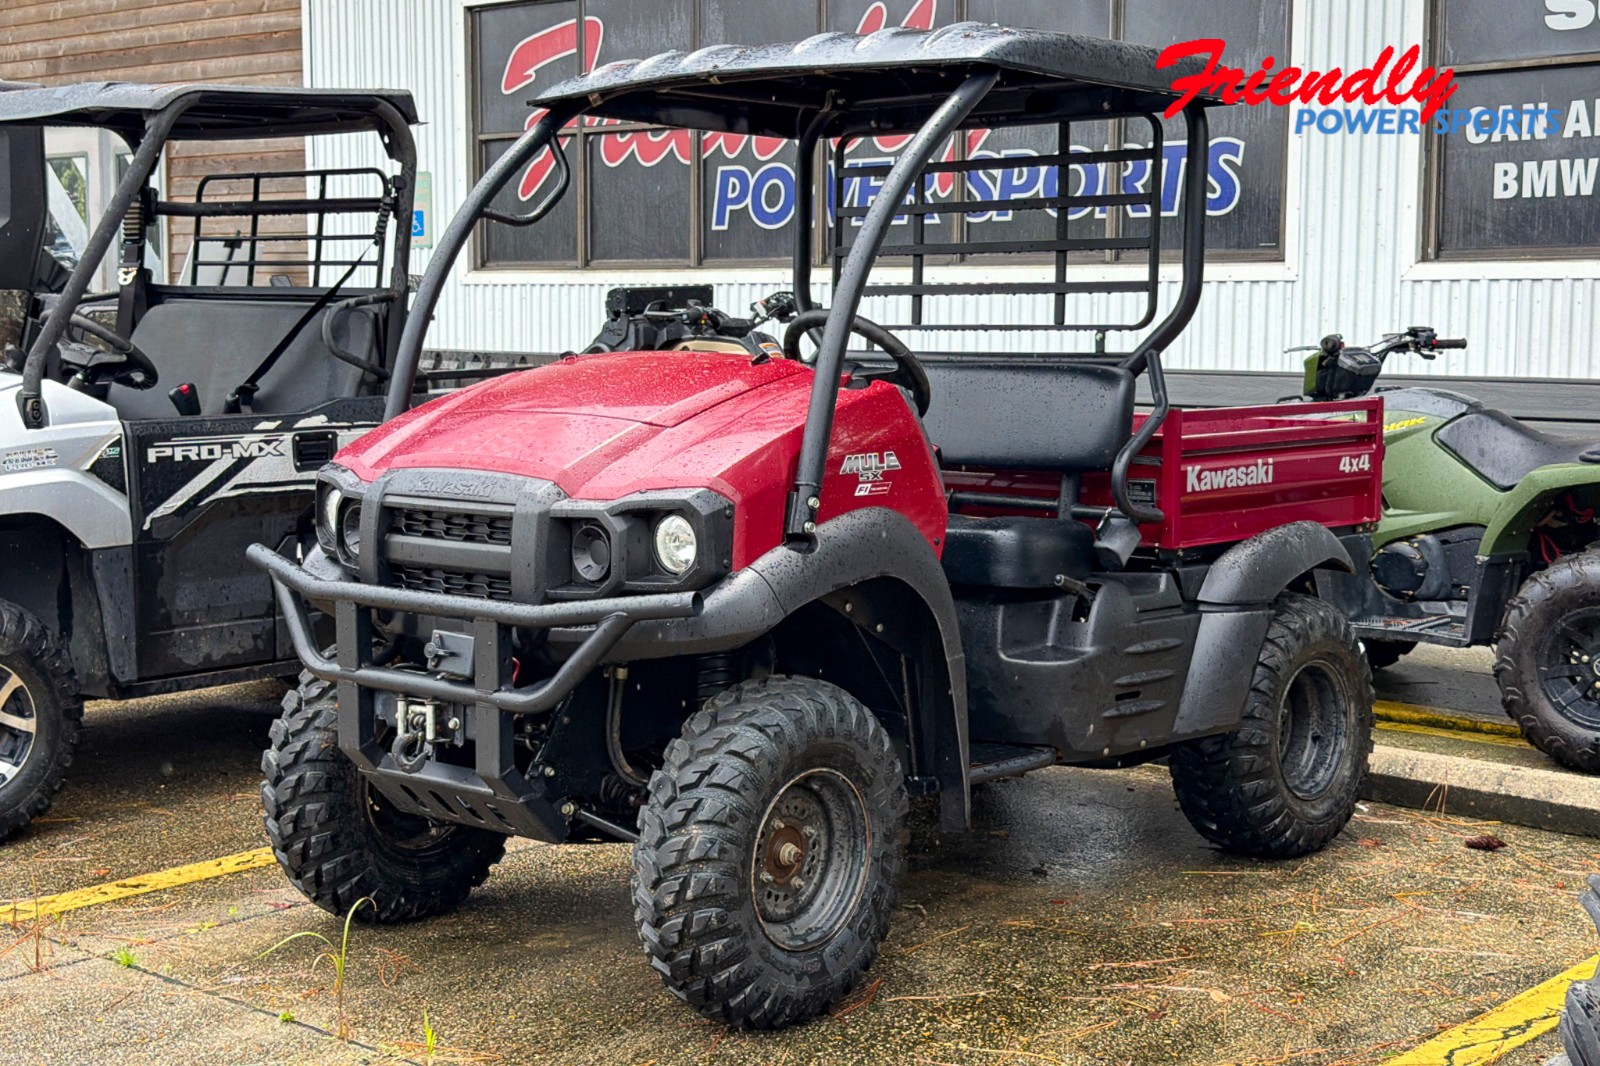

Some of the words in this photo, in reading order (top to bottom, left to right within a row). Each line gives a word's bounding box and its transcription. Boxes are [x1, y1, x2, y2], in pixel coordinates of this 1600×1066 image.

[1562, 99, 1600, 138] A
[1493, 158, 1600, 199] BMW
[147, 440, 286, 463] PRO-MX
[840, 451, 901, 475] MULE
[859, 470, 883, 481] SX
[1187, 457, 1274, 493] Kawasaki
[1339, 454, 1371, 474] 4x4
